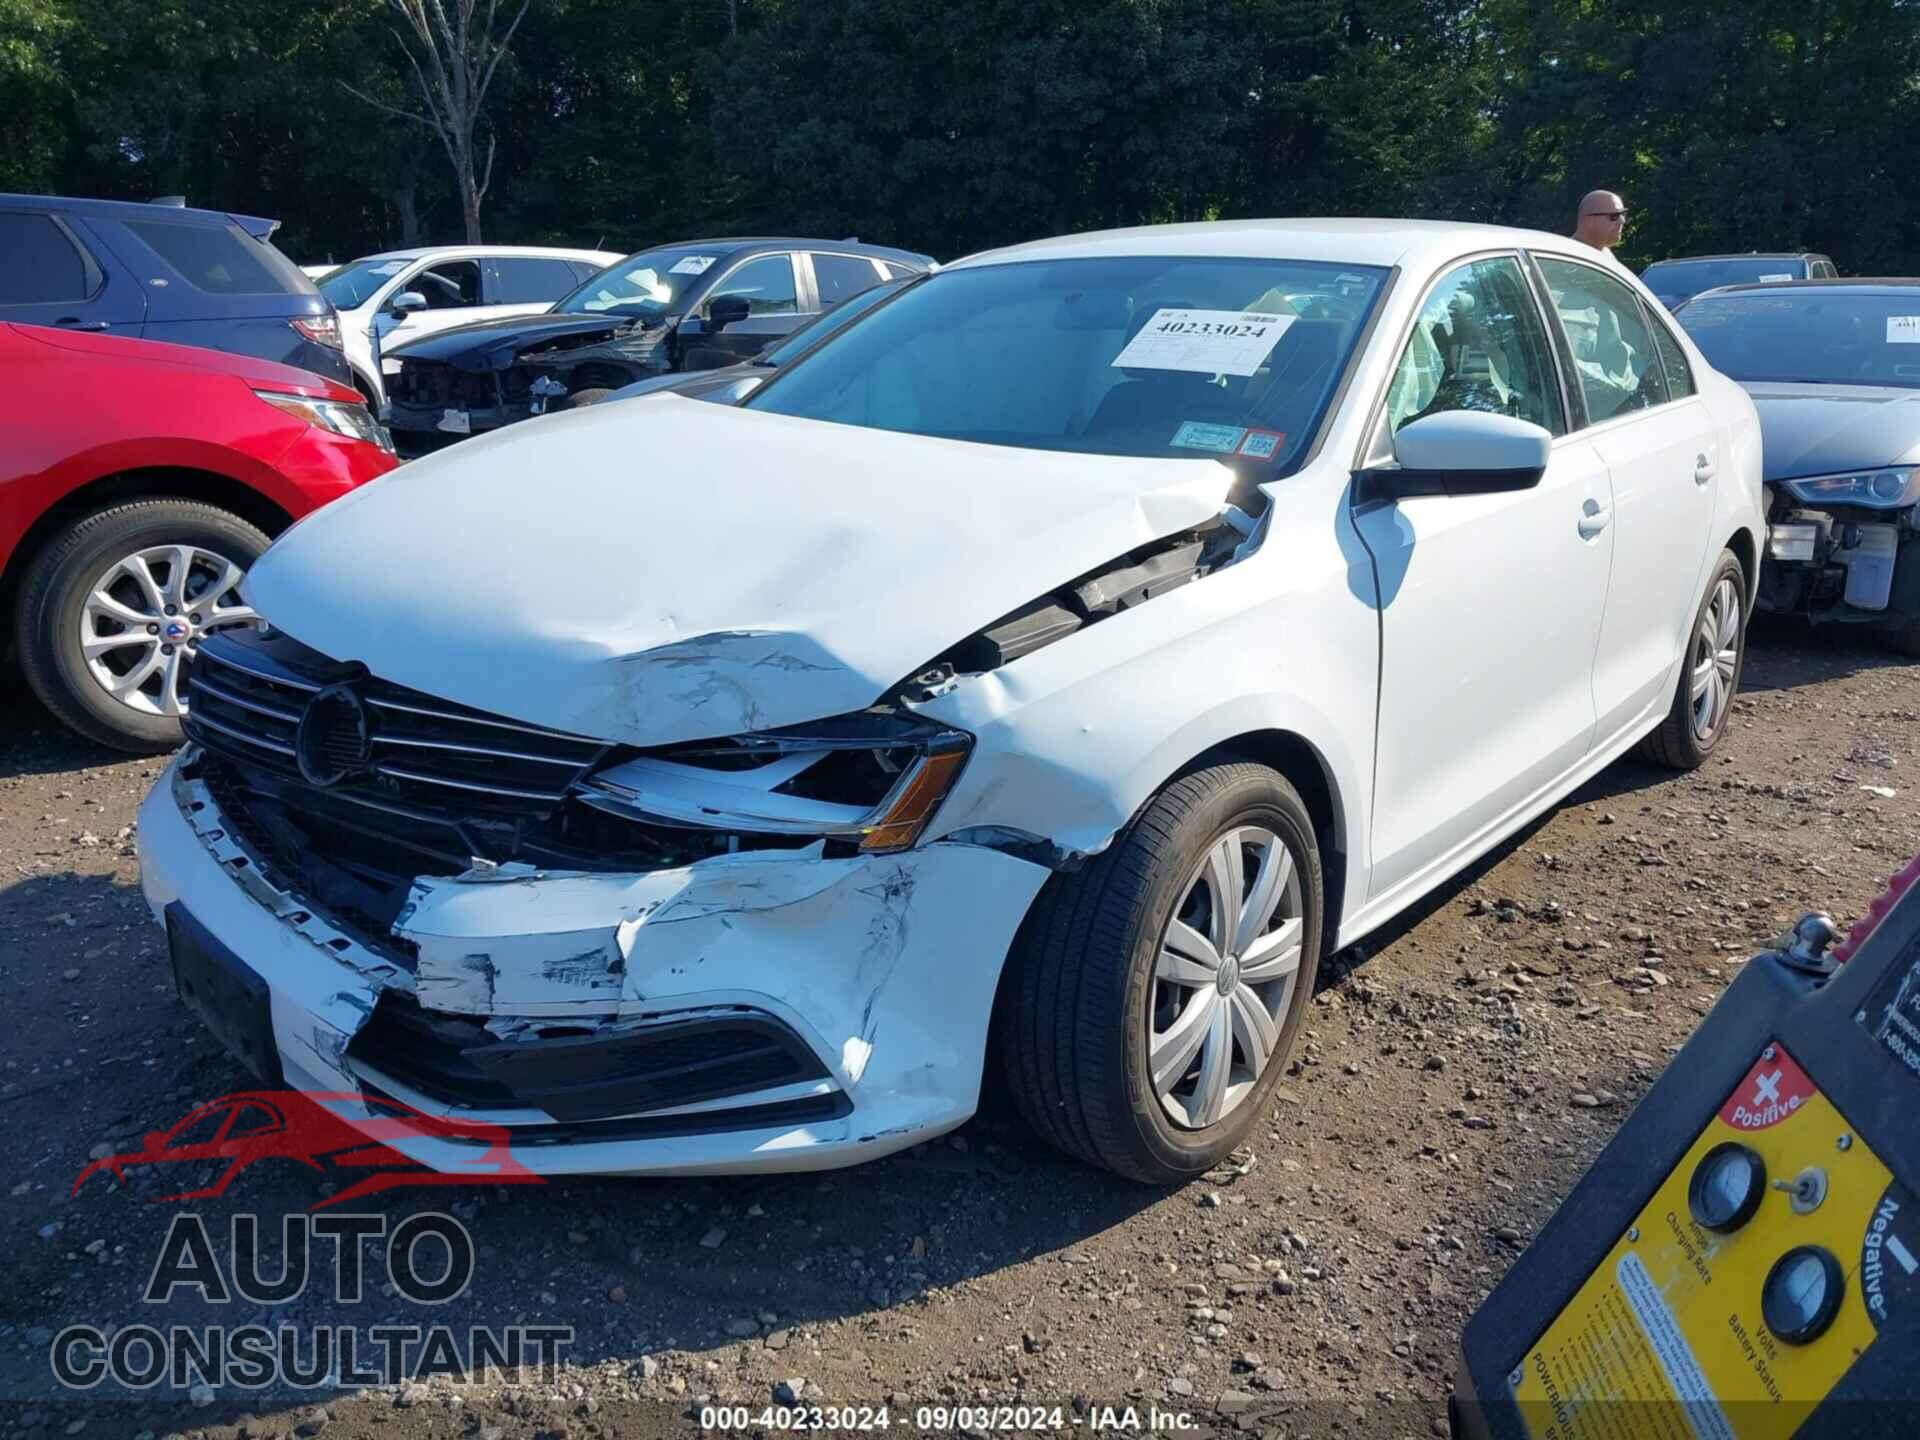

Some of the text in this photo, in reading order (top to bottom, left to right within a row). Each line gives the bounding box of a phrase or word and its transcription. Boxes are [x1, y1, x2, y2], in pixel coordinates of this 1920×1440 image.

[1157, 321, 1267, 338] 40233024
[1731, 1095, 1800, 1128] Positive
[1666, 1211, 1712, 1285] Charging Rate
[1865, 1197, 1900, 1310] Negative
[1728, 1314, 1783, 1404] Battery Status
[1756, 1325, 1778, 1360] Volts
